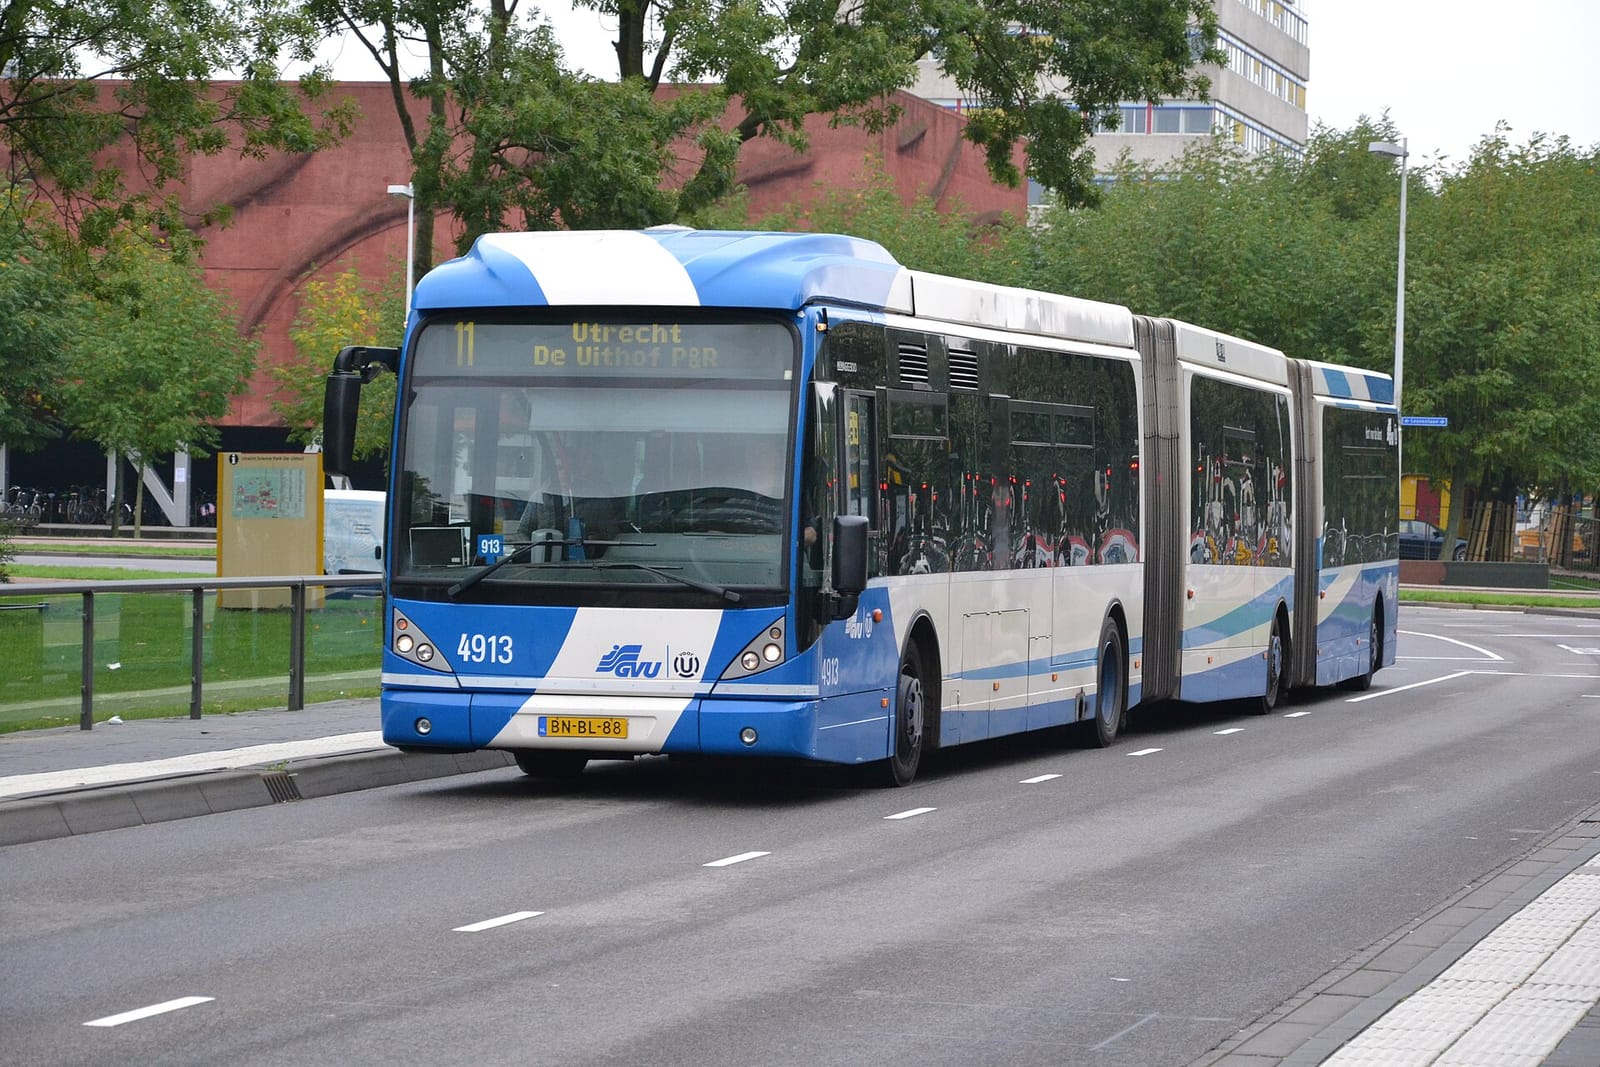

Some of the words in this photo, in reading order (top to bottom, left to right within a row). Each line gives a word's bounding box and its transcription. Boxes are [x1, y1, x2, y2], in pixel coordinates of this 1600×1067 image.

[572, 322, 682, 343] Utrecht
[454, 321, 475, 367] 11
[533, 345, 566, 367] De
[576, 346, 662, 367] Uithof
[481, 539, 500, 554] 913
[457, 633, 513, 664] 4913
[614, 661, 662, 679] GVU
[821, 657, 839, 686] 4913
[550, 719, 622, 735] BN-BL-88
